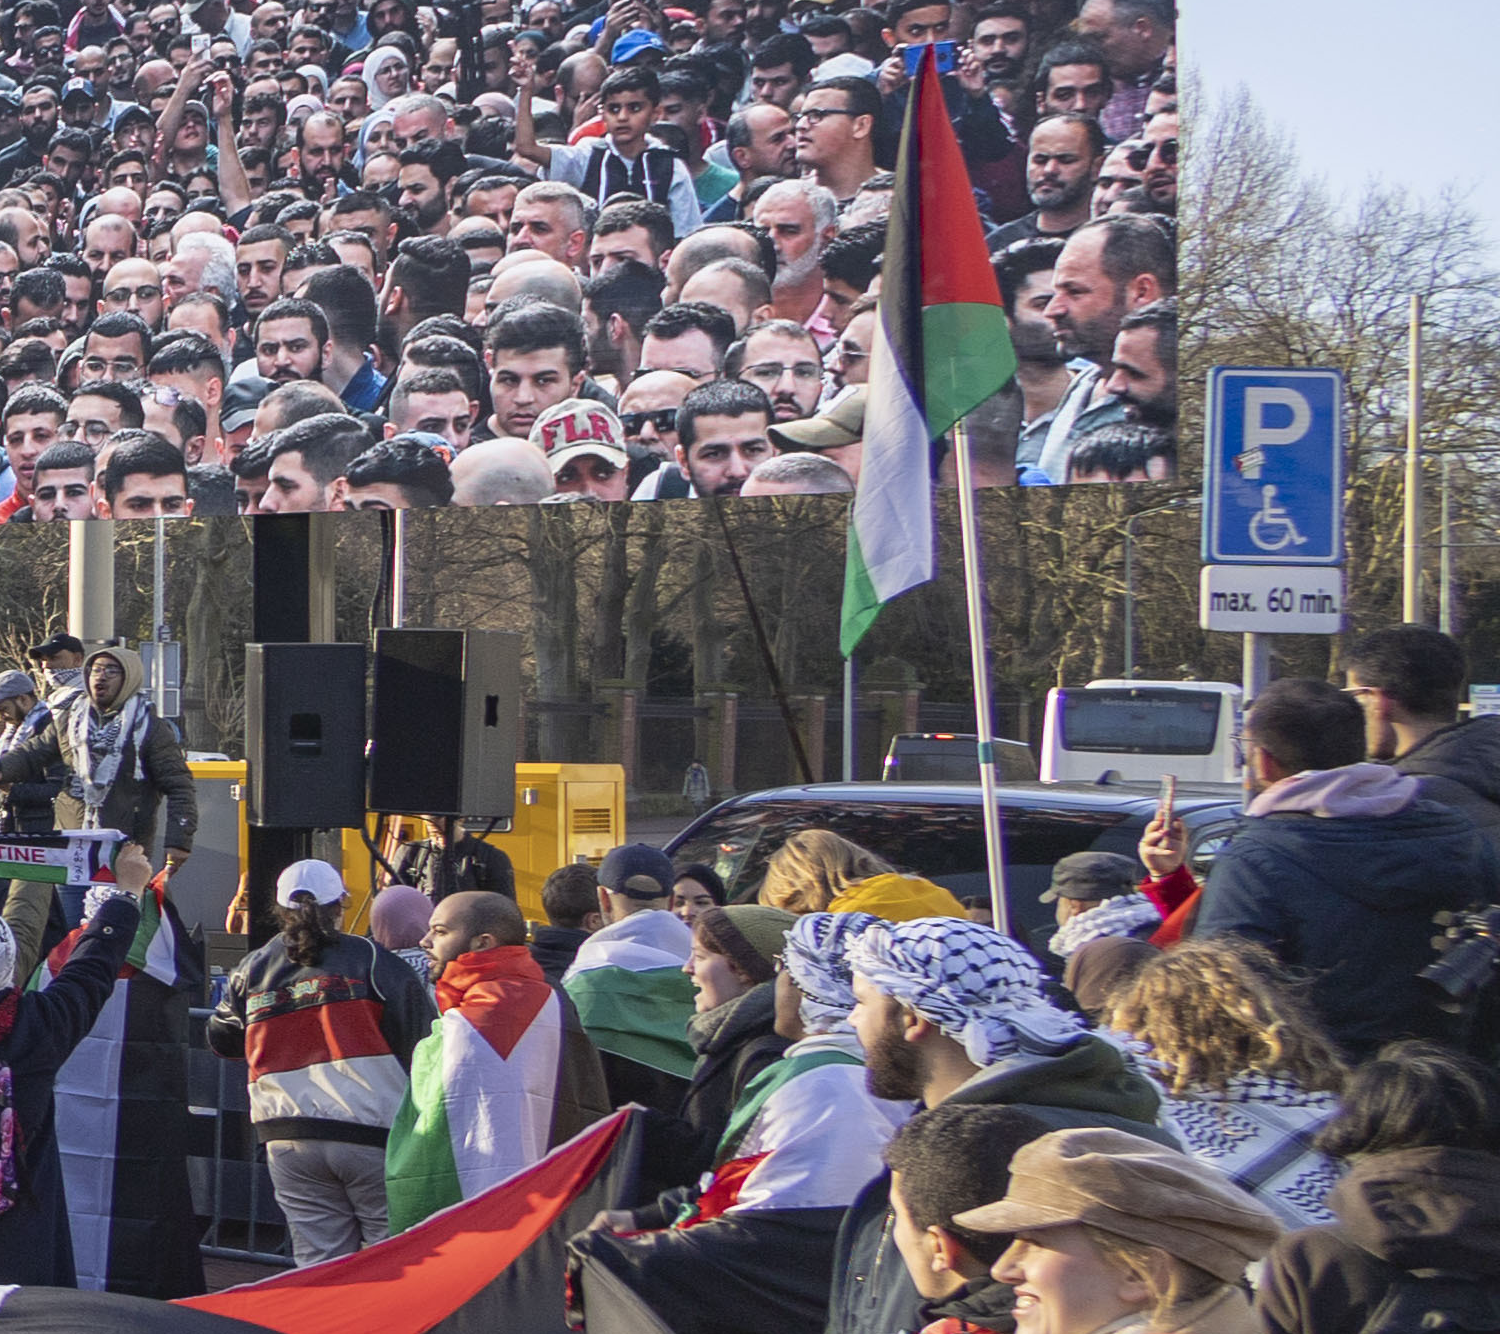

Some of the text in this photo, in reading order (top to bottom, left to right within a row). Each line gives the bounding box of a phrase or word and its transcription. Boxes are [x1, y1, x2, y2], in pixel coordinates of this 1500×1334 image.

[1242, 386, 1312, 480] P
[1210, 586, 1338, 614] max. 60 min.
